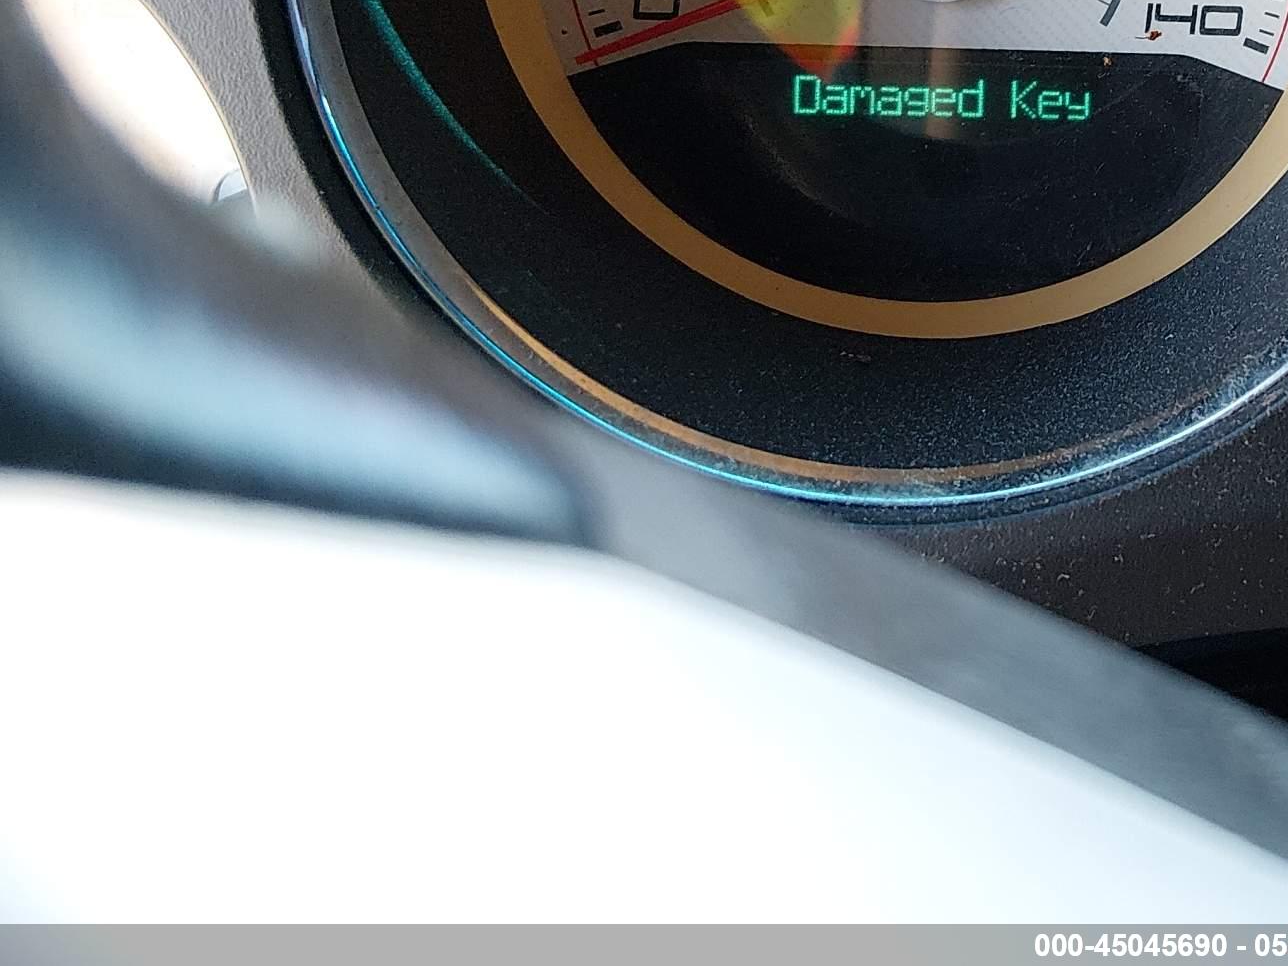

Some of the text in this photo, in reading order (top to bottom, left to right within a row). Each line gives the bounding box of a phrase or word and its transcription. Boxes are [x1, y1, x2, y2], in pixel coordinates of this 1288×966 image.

[1144, 2, 1243, 36] 140
[793, 74, 1091, 120] Damaged Key
